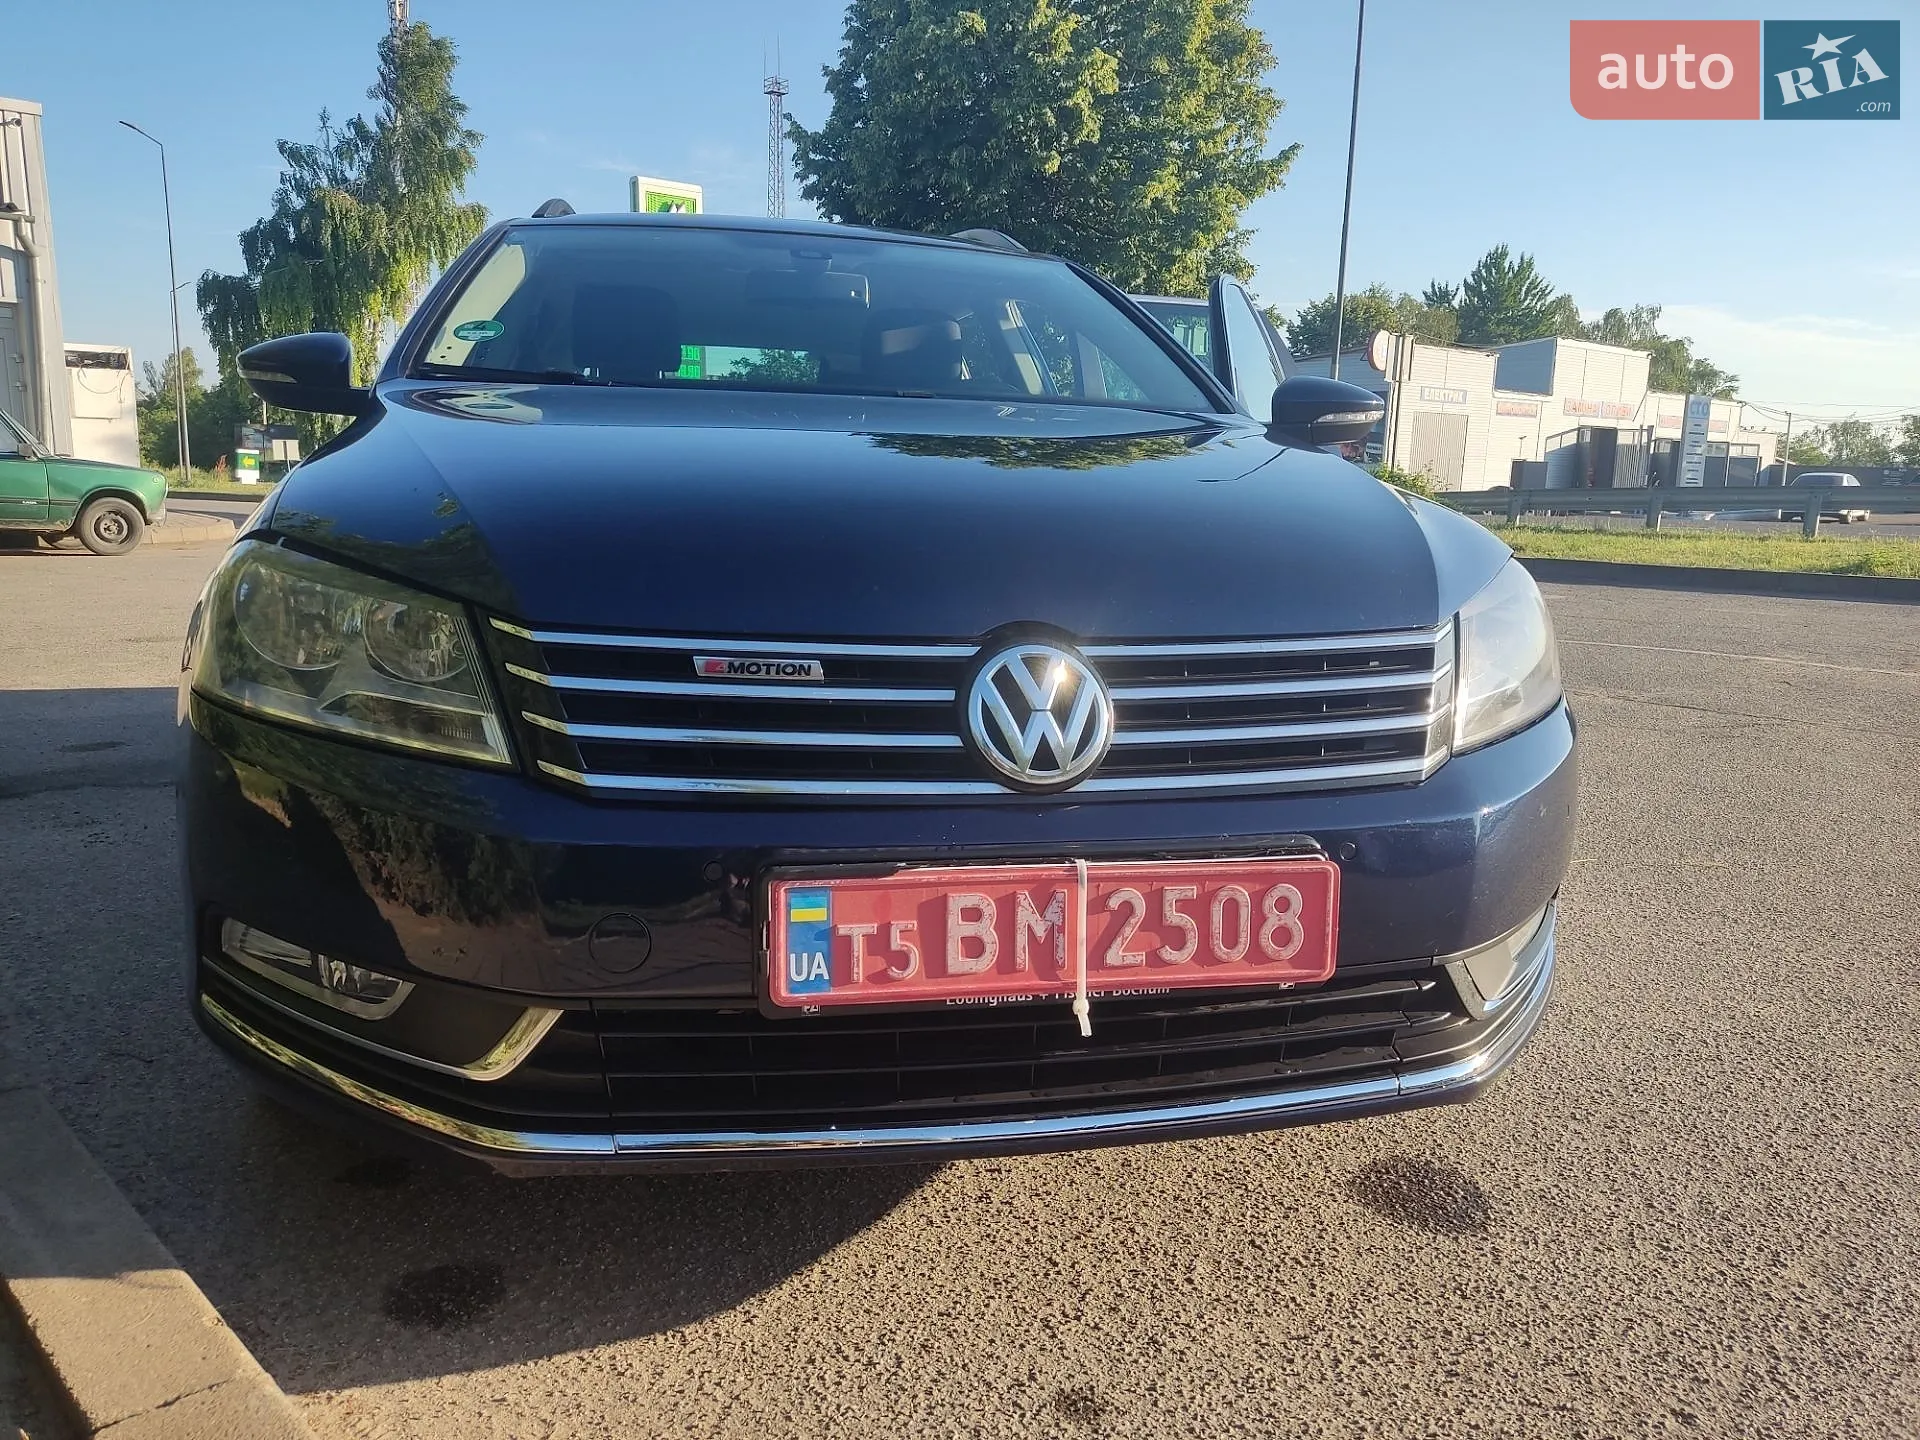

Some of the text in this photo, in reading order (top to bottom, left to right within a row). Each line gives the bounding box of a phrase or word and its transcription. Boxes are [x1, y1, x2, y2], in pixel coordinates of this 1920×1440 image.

[835, 882, 1305, 983] T5 BM 2508
[790, 952, 829, 983] UA
